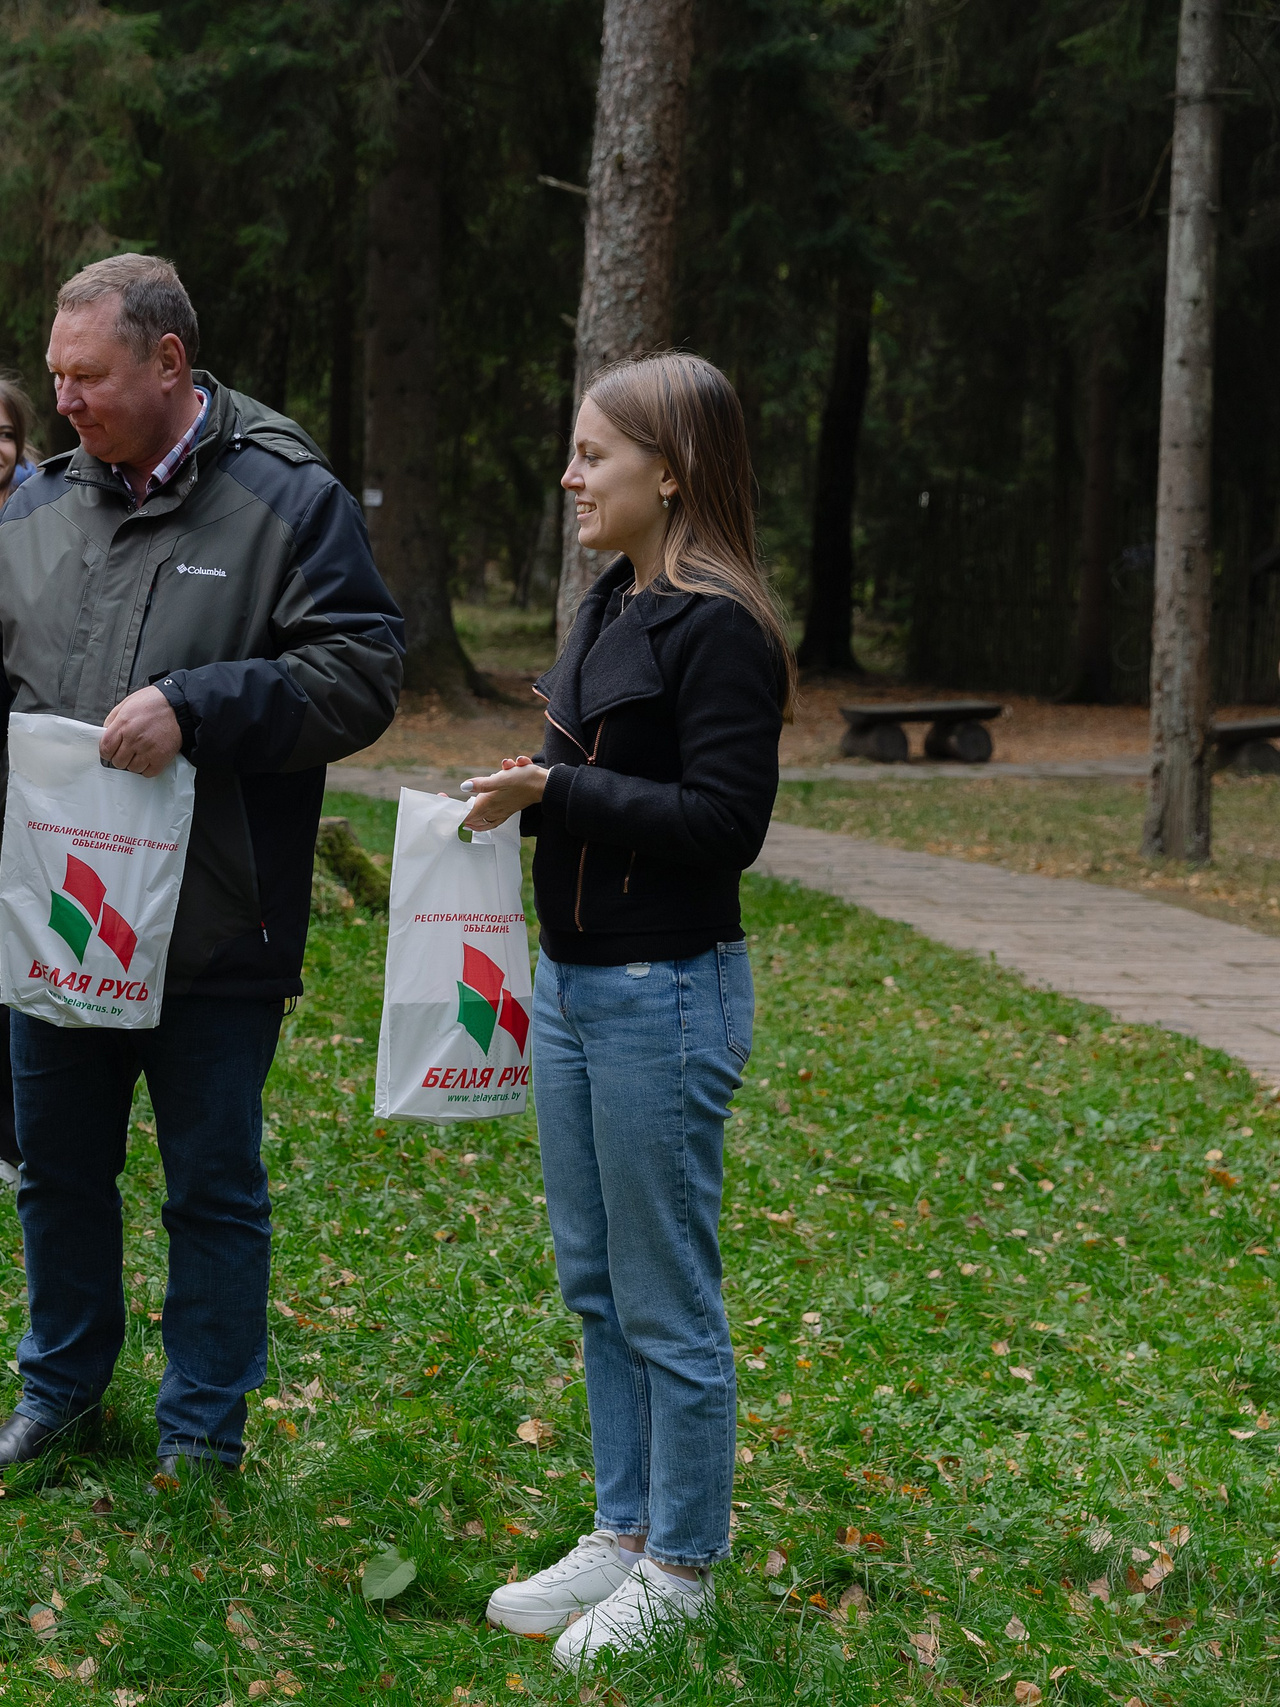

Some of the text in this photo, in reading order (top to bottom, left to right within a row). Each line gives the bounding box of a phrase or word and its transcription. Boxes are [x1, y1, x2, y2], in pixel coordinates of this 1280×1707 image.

[187, 565, 227, 577] Columbia
[27, 820, 180, 852] РЕСПУБЛИКАНСКОЕ ОБЩЕСТВЕННОЕ
[72, 838, 135, 855] ОБЪЕДИНЕНИЕ
[28, 959, 149, 1002] БЕЛАЯ РУСЬ
[421, 1067, 495, 1088] БЕЛАЯ
